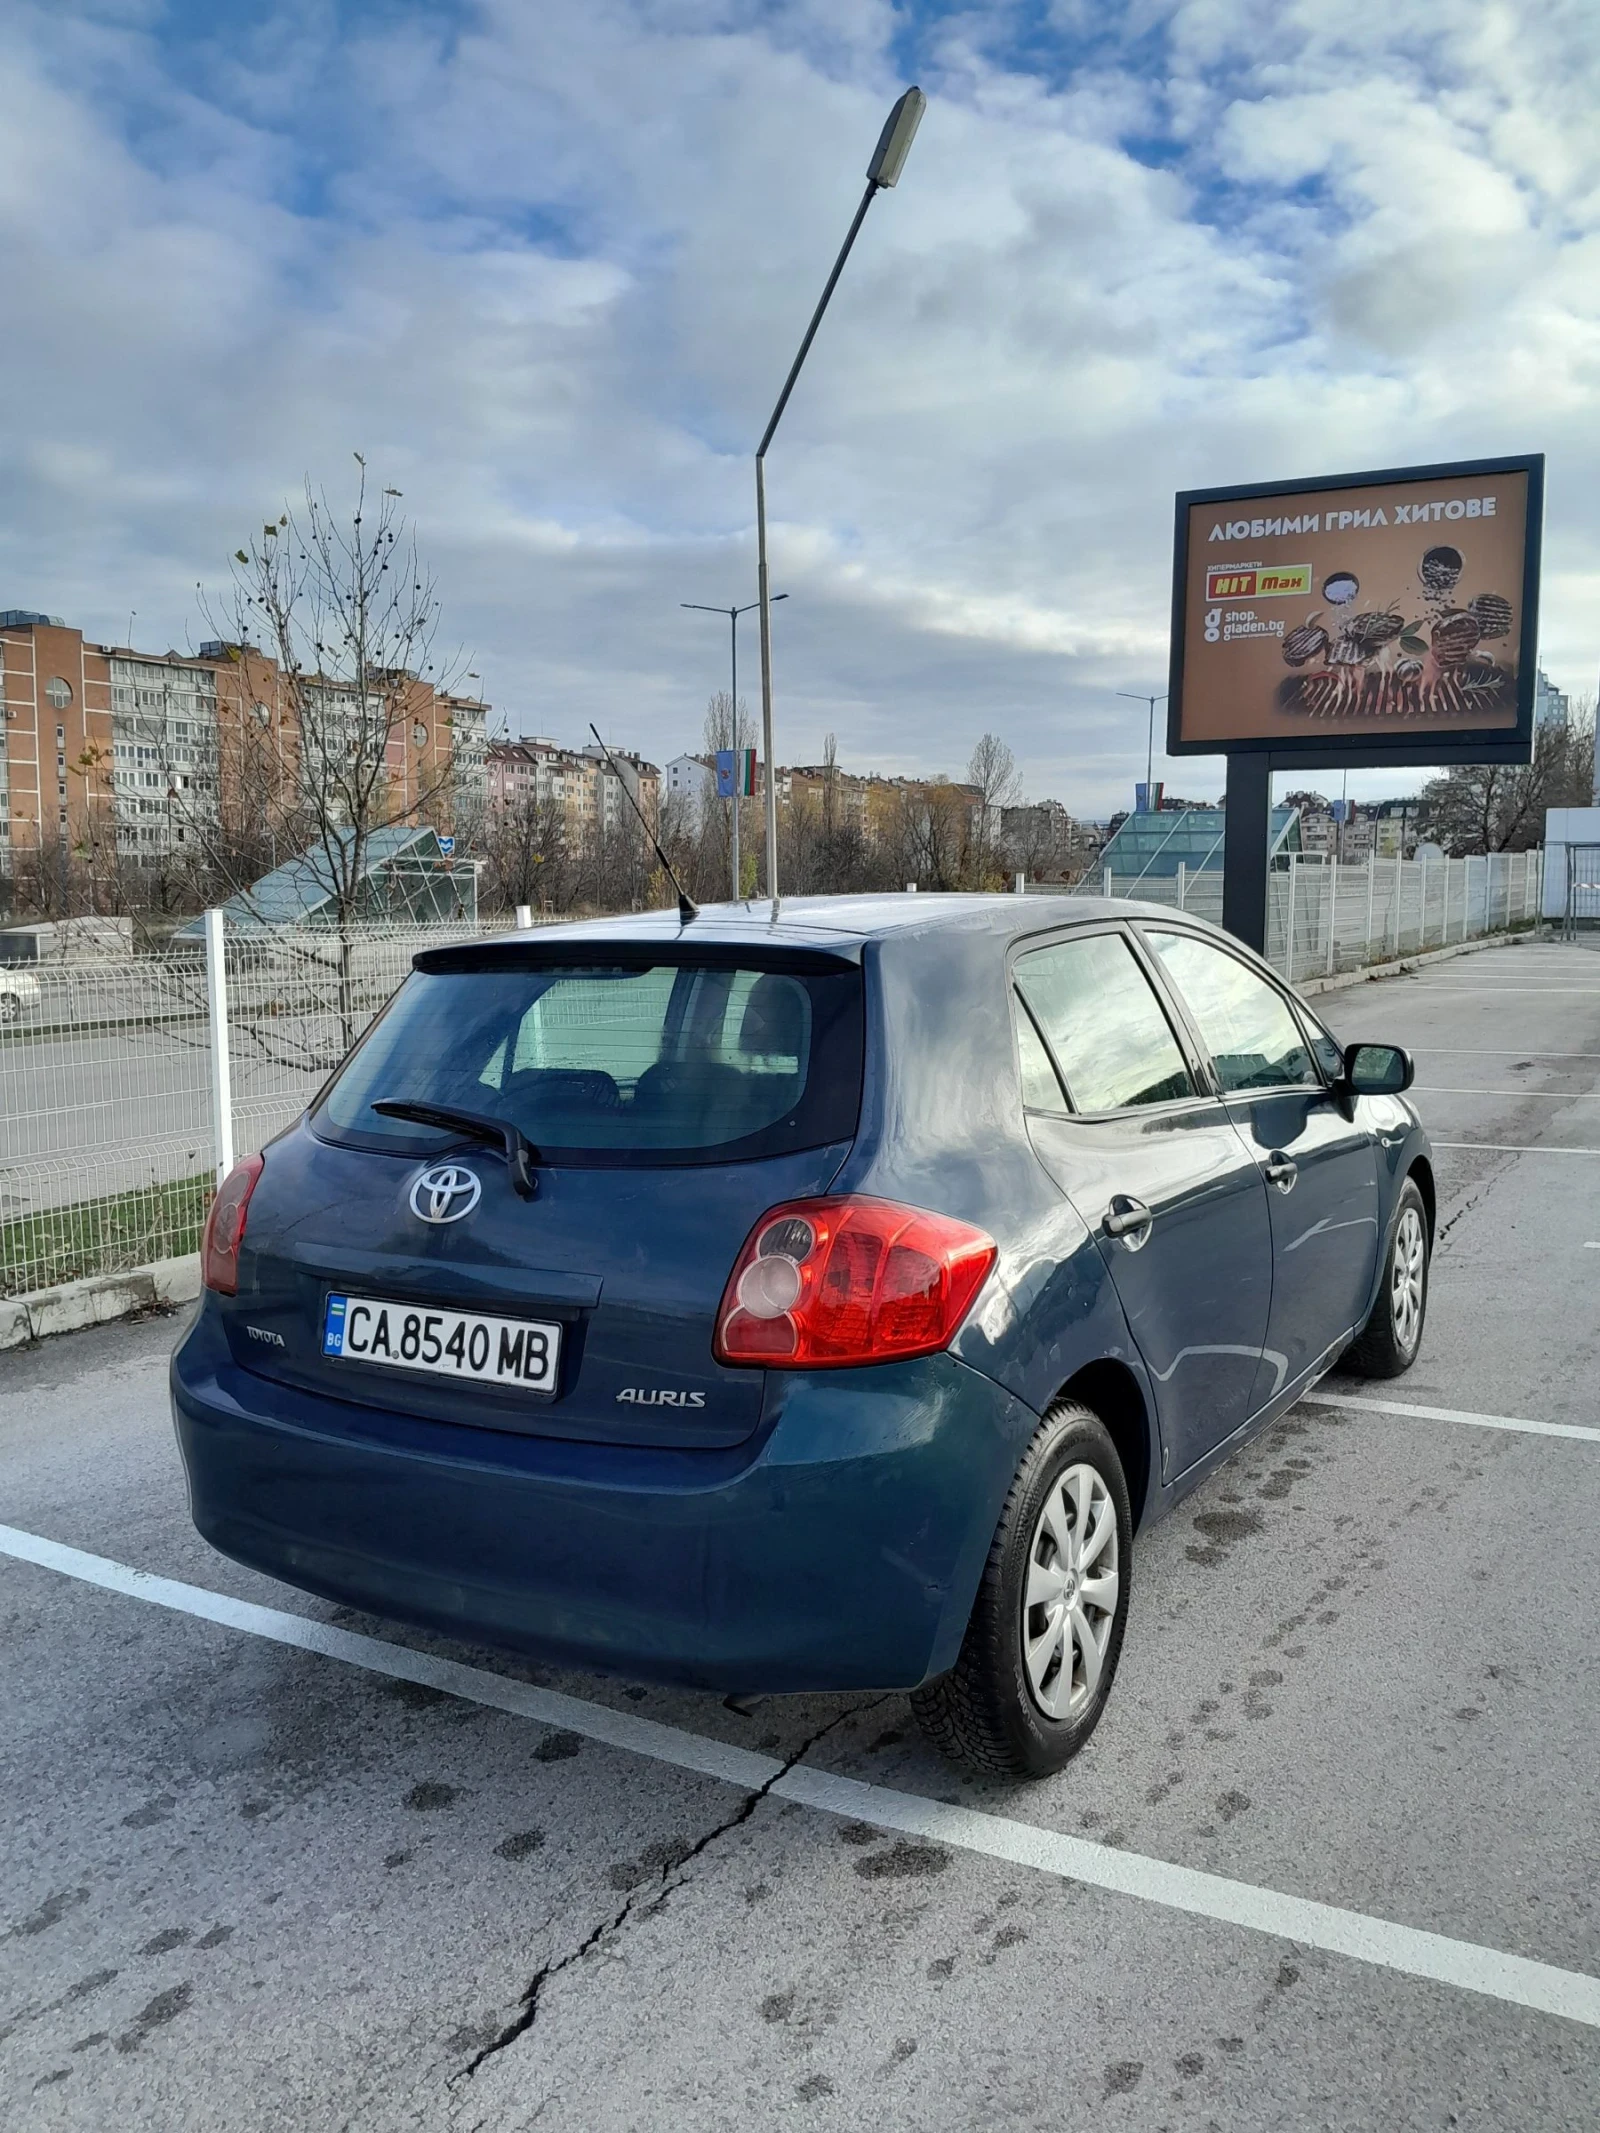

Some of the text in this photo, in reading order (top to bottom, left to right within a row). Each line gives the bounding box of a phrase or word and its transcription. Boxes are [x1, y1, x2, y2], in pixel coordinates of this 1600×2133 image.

[1208, 497, 1497, 542] ЛЮБИМИ ГРИЛ ХИТОВЕ
[1207, 561, 1263, 572] ХИПЕРМАРКЕТИ
[1215, 576, 1252, 594] HIT
[1223, 620, 1285, 641] gladen.bg
[246, 1325, 285, 1347] TOYOTA
[327, 1332, 341, 1347] BG
[615, 1388, 706, 1407] AURIS
